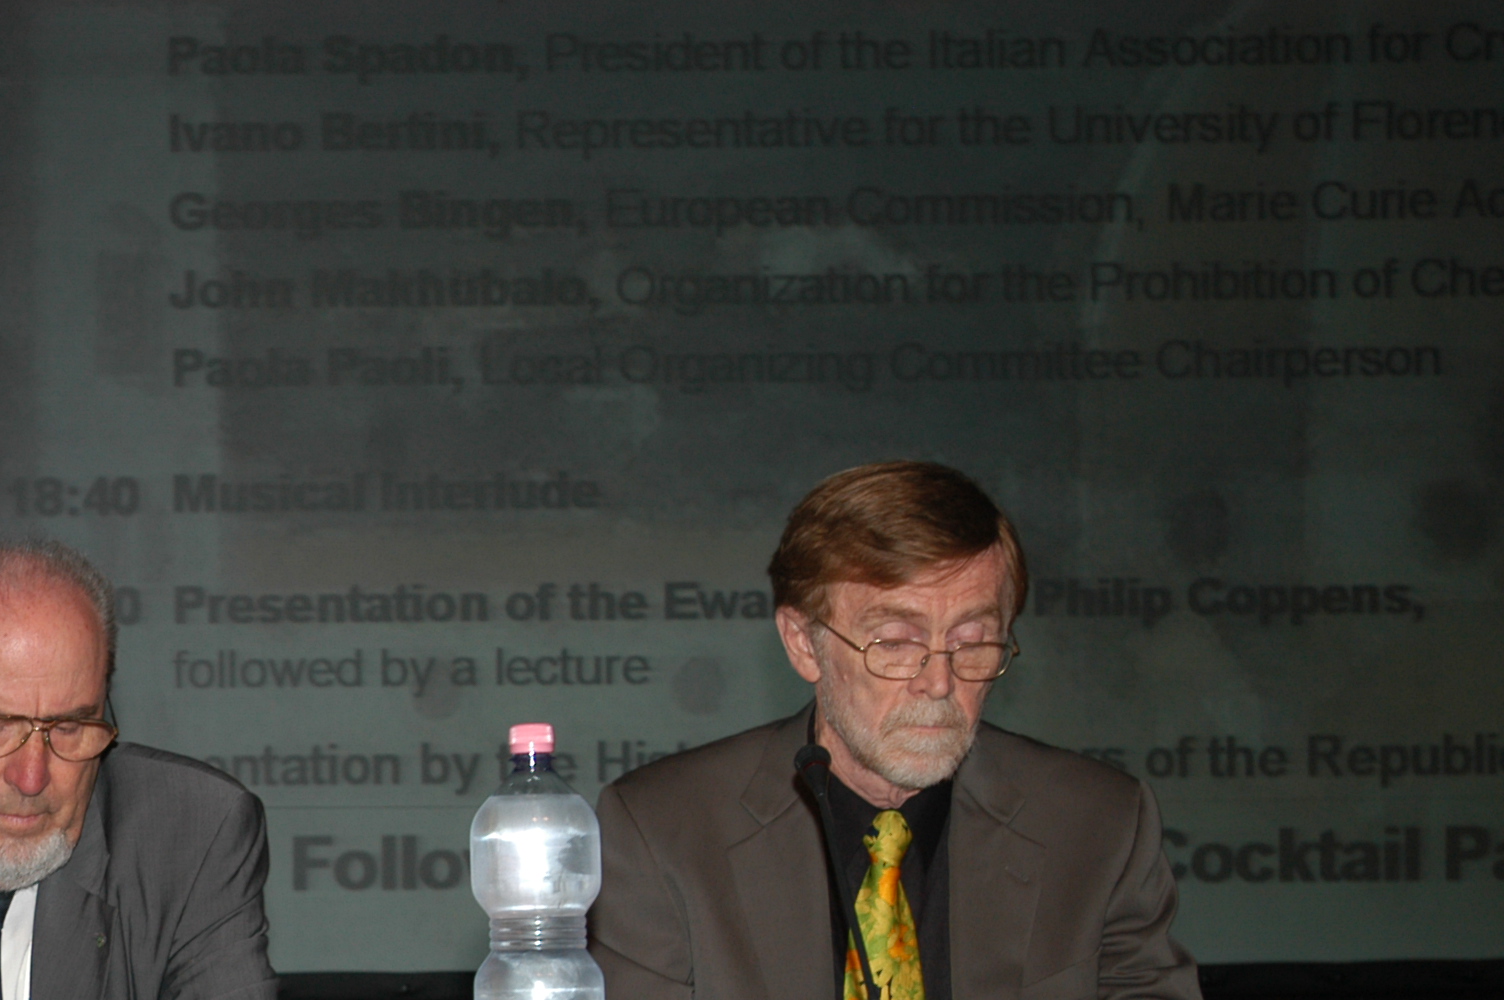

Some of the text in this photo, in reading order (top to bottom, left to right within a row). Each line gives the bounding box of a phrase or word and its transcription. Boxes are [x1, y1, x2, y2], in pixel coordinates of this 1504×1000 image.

[168, 20, 1504, 84] Paola Spadon, President of the Italian Association for Cr
[169, 99, 1504, 160] Ivano Bertini, Representative for the University of Floren
[169, 191, 382, 240] Georges
[399, 190, 589, 240] Bingen,
[606, 188, 831, 236] European
[847, 185, 1145, 231] Commission,
[1167, 182, 1297, 222] Marie
[1312, 180, 1438, 221] Curie
[169, 270, 293, 310] John
[312, 268, 601, 314] Makhubalo,
[616, 265, 909, 316] Organization
[925, 263, 986, 303] for
[1002, 262, 1075, 302] the
[1090, 259, 1337, 301] Prohibition
[1353, 258, 1400, 299] of
[172, 338, 1443, 396] Paola Paoli, Local Organizing Committee Chairperson
[9, 473, 602, 517] 18:40 Musical Interlude
[173, 585, 487, 626] Presentation
[506, 583, 555, 623] of
[569, 582, 648, 621] the
[665, 581, 772, 620] Ewa
[1032, 577, 1172, 626] Philip
[1187, 577, 1426, 626] Coppens,
[174, 648, 650, 696] followed by a lecture
[421, 742, 480, 795] by
[1146, 735, 1194, 779] of
[1208, 735, 1288, 778] the
[292, 836, 470, 892] Follo
